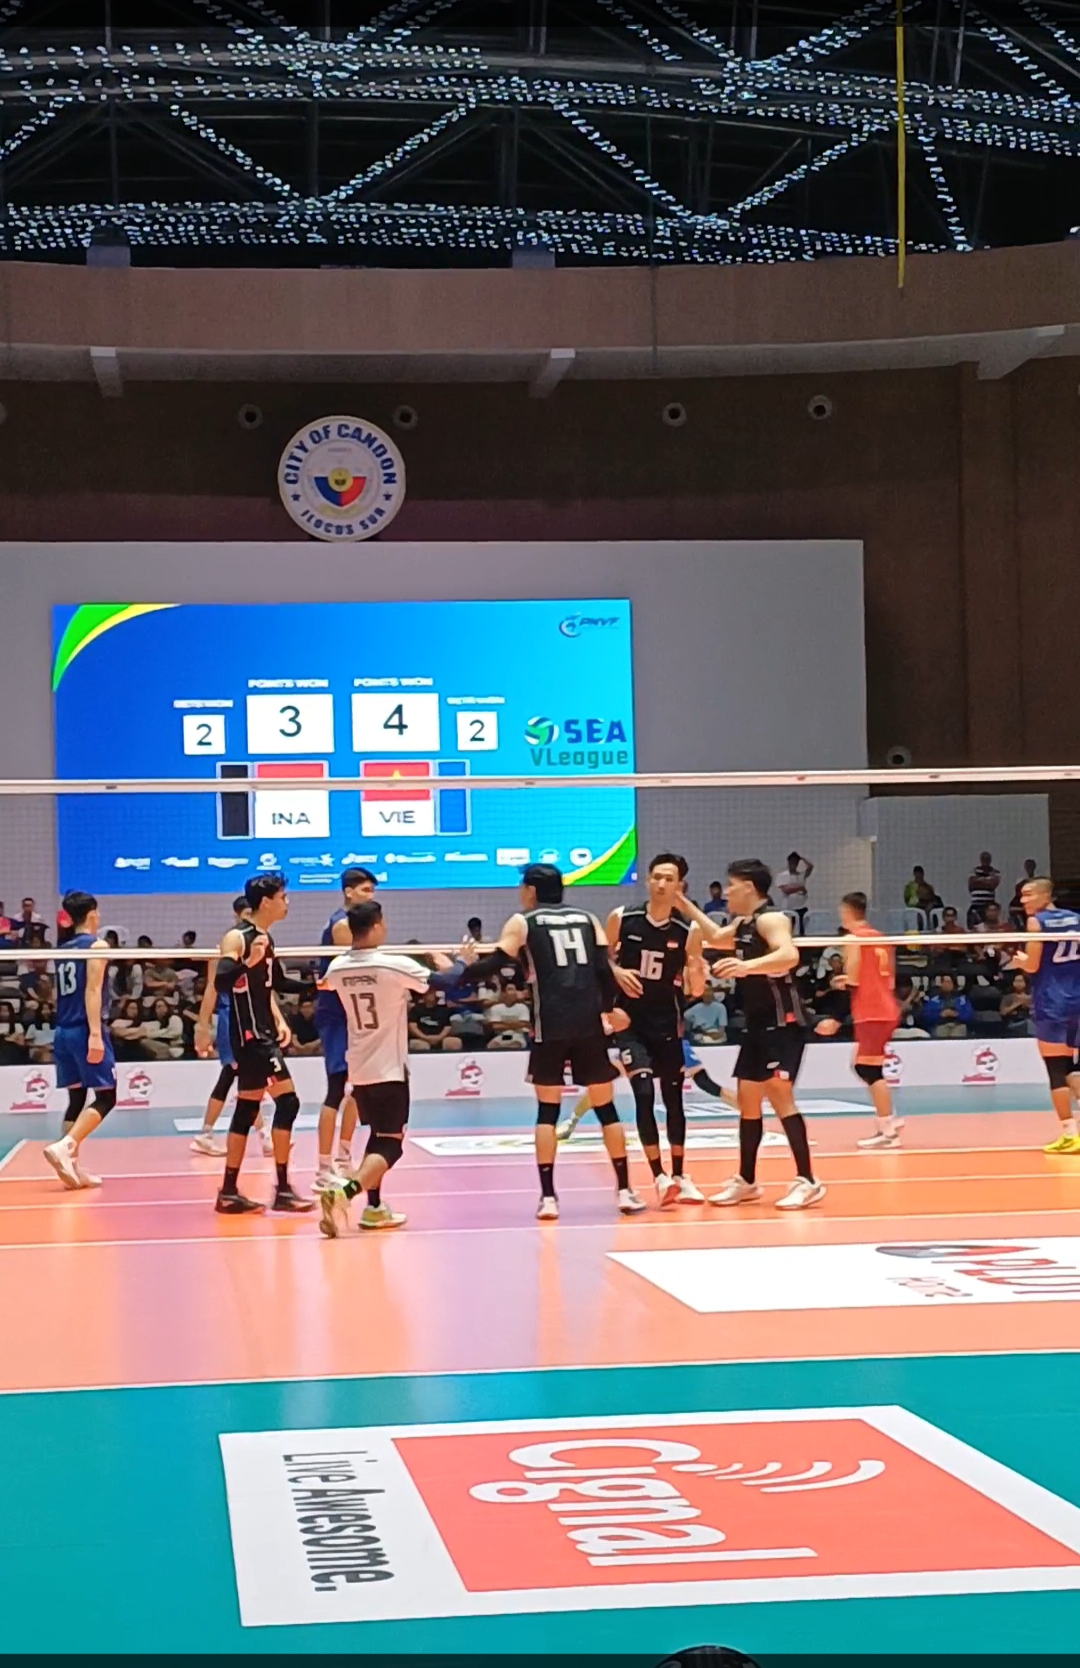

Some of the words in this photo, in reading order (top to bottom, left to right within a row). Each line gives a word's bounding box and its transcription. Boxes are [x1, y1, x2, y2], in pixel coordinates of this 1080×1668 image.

[284, 441, 309, 485] CITY
[309, 425, 331, 444] OF
[337, 424, 397, 484] CANDON
[301, 509, 354, 535] ILOCOS
[359, 507, 386, 531] SUR
[196, 723, 212, 746] 2
[279, 705, 302, 737] 3
[383, 703, 408, 736] 4
[469, 719, 485, 742] 2
[564, 718, 627, 745] SEA
[271, 812, 311, 825] INA
[379, 810, 416, 824] VIE
[548, 927, 589, 967] 14
[57, 961, 77, 997] 13
[640, 949, 665, 980] 16
[349, 992, 380, 1030] 13
[282, 1450, 378, 1483] Live
[469, 1438, 818, 1567] Cignal
[291, 1489, 395, 1592] Awesome.
